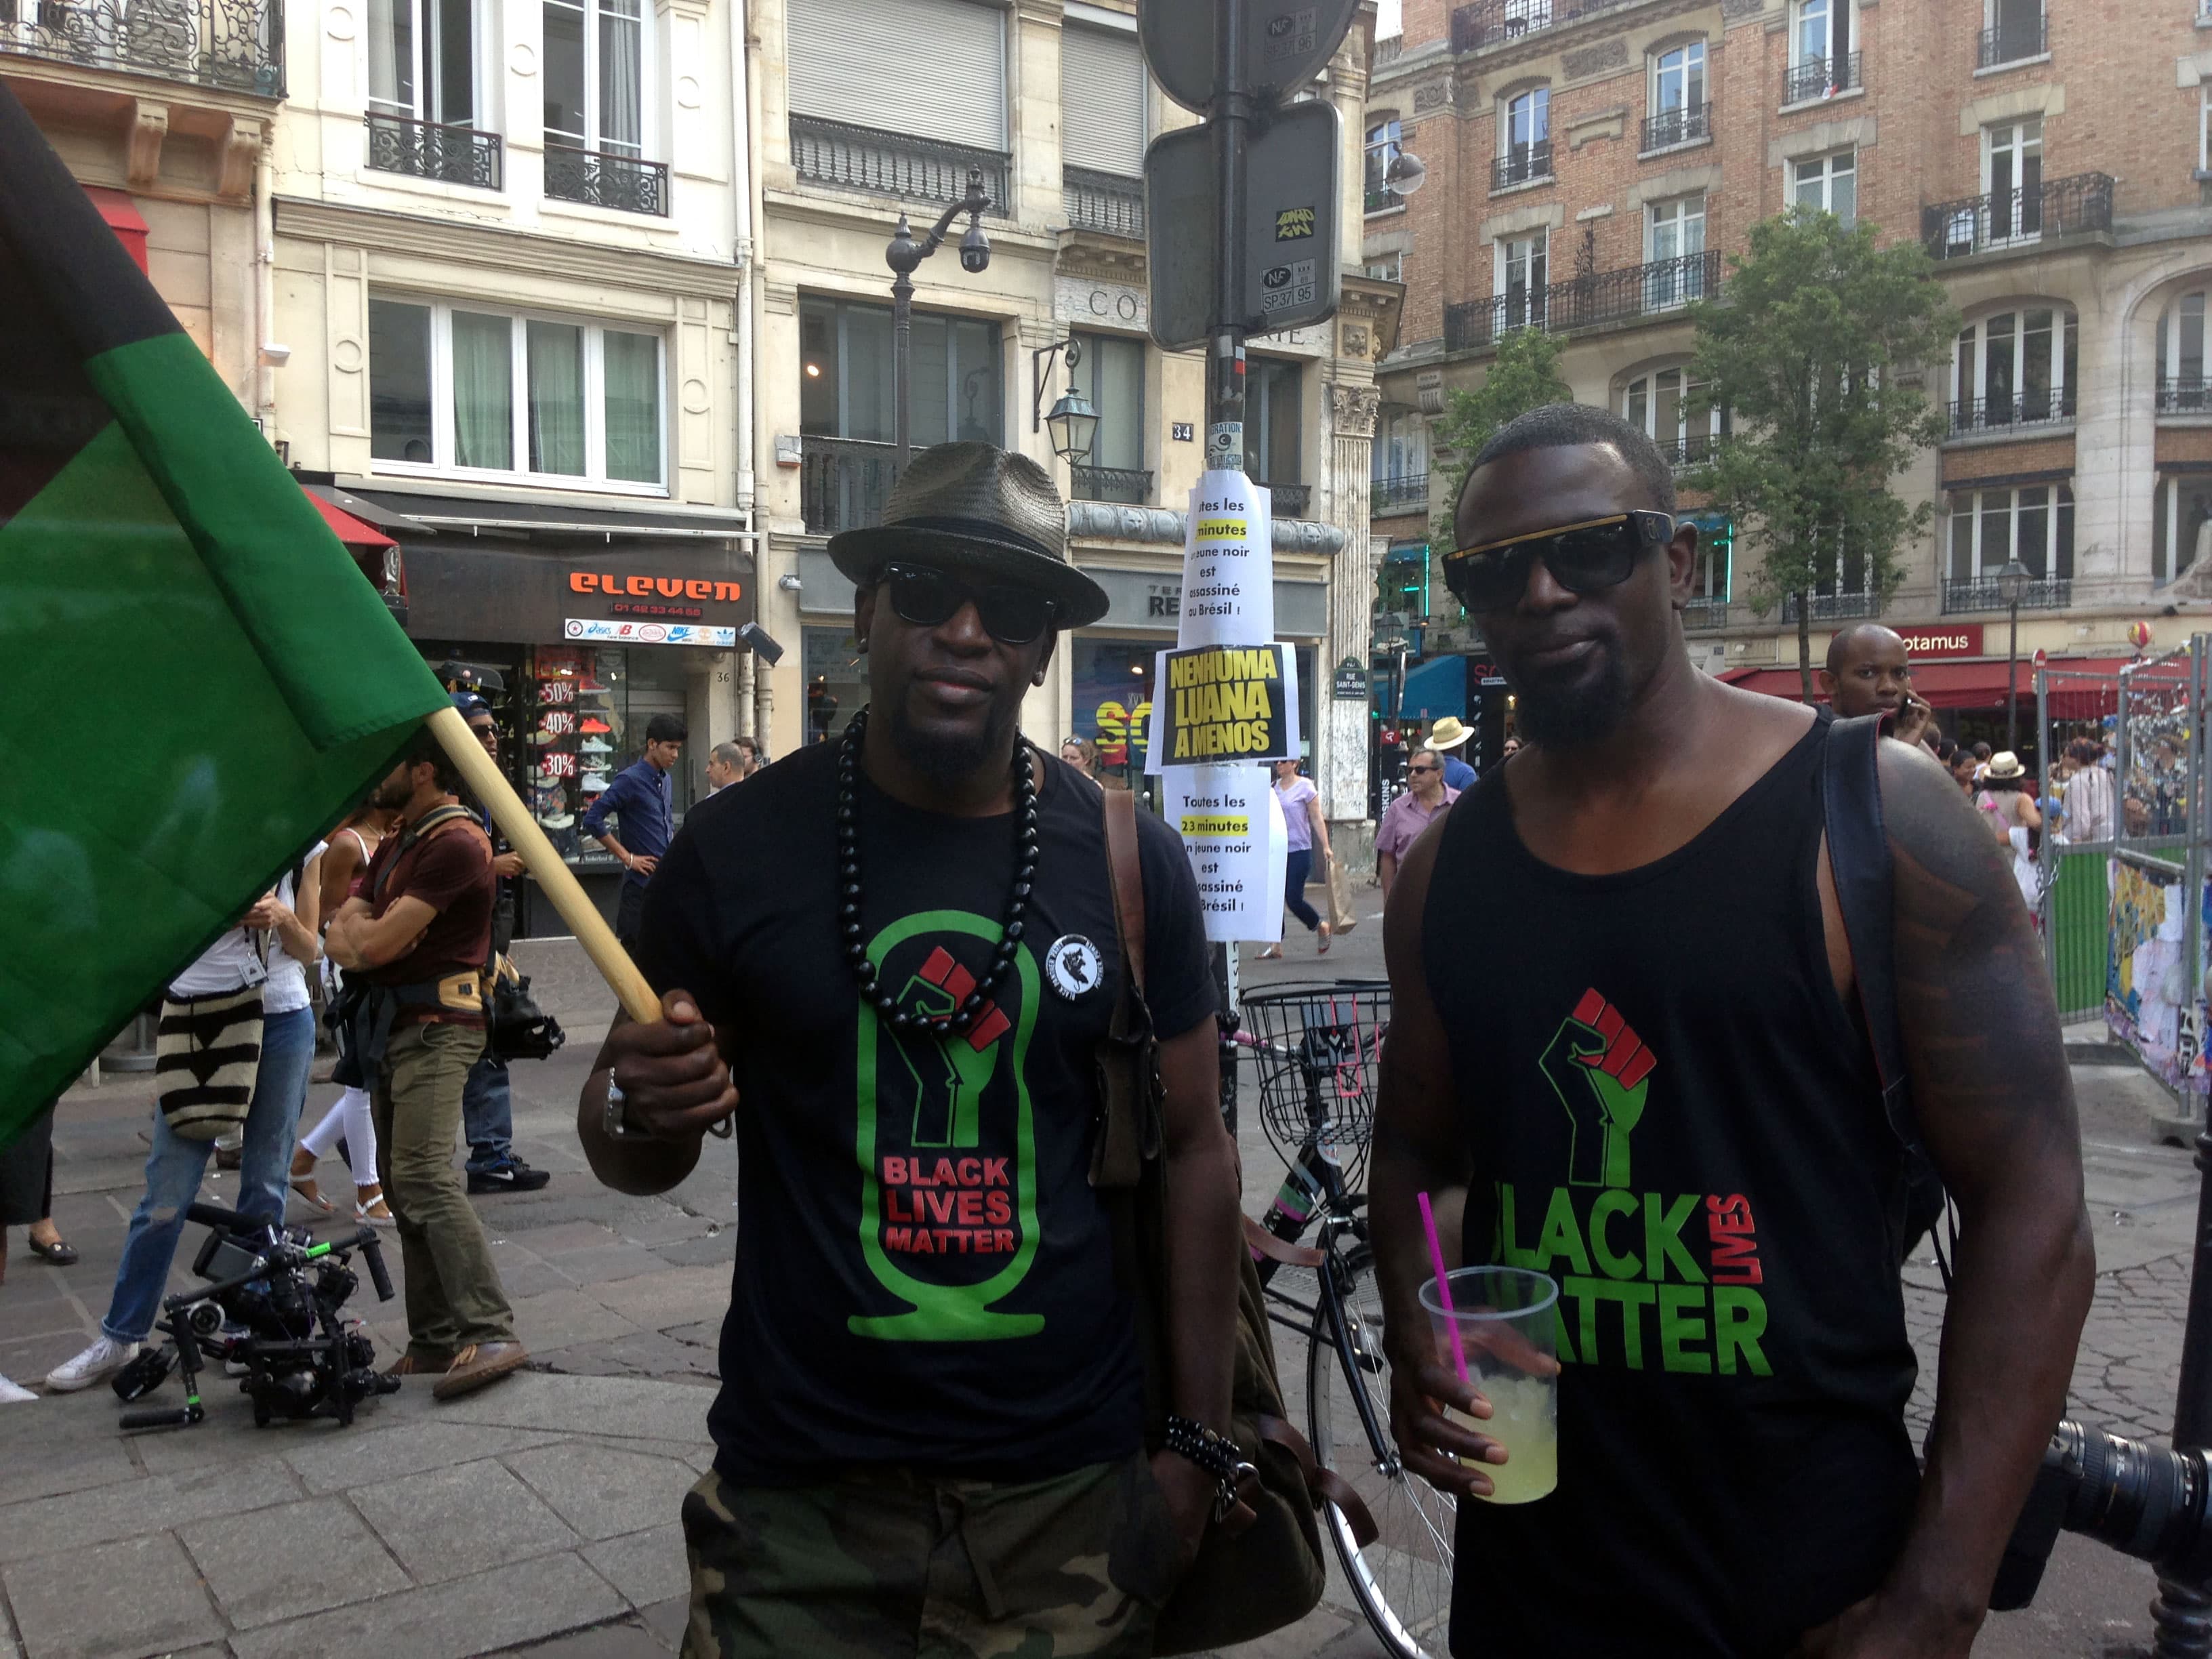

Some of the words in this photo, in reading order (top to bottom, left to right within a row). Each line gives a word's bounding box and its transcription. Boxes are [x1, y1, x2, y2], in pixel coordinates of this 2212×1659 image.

[1297, 287, 1311, 302] 95
[1174, 424, 1191, 440] 34
[1224, 497, 1244, 512] les
[1223, 546, 1250, 557] noir
[1200, 566, 1216, 578] est
[1189, 583, 1240, 598] assassiné
[1189, 609, 1197, 617] au
[1199, 602, 1232, 615] Brésil
[1170, 649, 1277, 689] NENHUMA
[716, 672, 729, 682] 36
[541, 682, 573, 702] -50%
[1175, 680, 1272, 727] LUANA
[541, 713, 573, 733] -40%
[1192, 720, 1269, 757] MENOS
[542, 754, 574, 775] -30%
[1183, 796, 1219, 808] Toutes
[1224, 794, 1246, 808] les
[1181, 821, 1195, 832] 23
[1197, 819, 1248, 832] minutes
[1195, 842, 1221, 855] jeune
[1225, 842, 1251, 853] noir
[1202, 862, 1218, 874] est
[883, 1156, 1009, 1187] BLACK
[886, 1191, 1011, 1225] LIVES
[1493, 1181, 1709, 1284] LACK
[1706, 1193, 1763, 1284] LIVES
[884, 1227, 1015, 1254] MATTER
